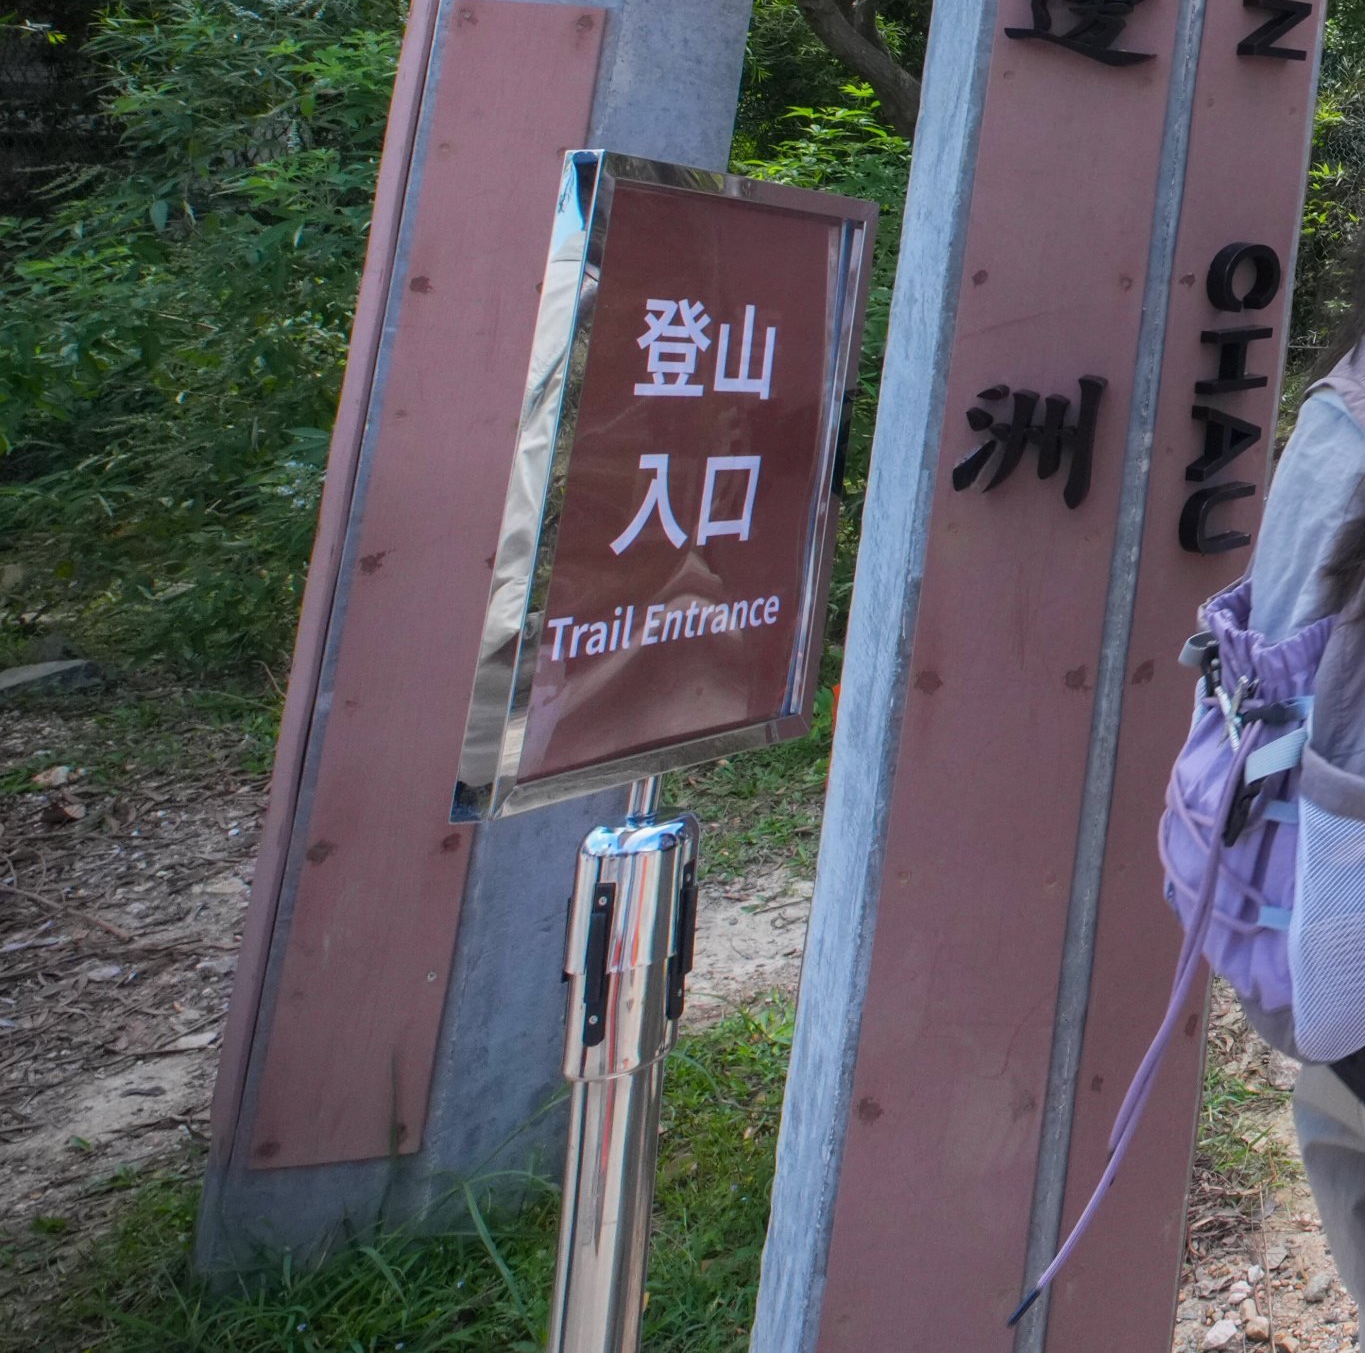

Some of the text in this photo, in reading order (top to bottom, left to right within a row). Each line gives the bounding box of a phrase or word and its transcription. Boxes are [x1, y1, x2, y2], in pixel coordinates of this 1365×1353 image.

[633, 298, 776, 400] 登山
[1177, 242, 1281, 557] CHAU
[610, 453, 761, 556] 入口
[547, 593, 780, 662] Trail Entrance
